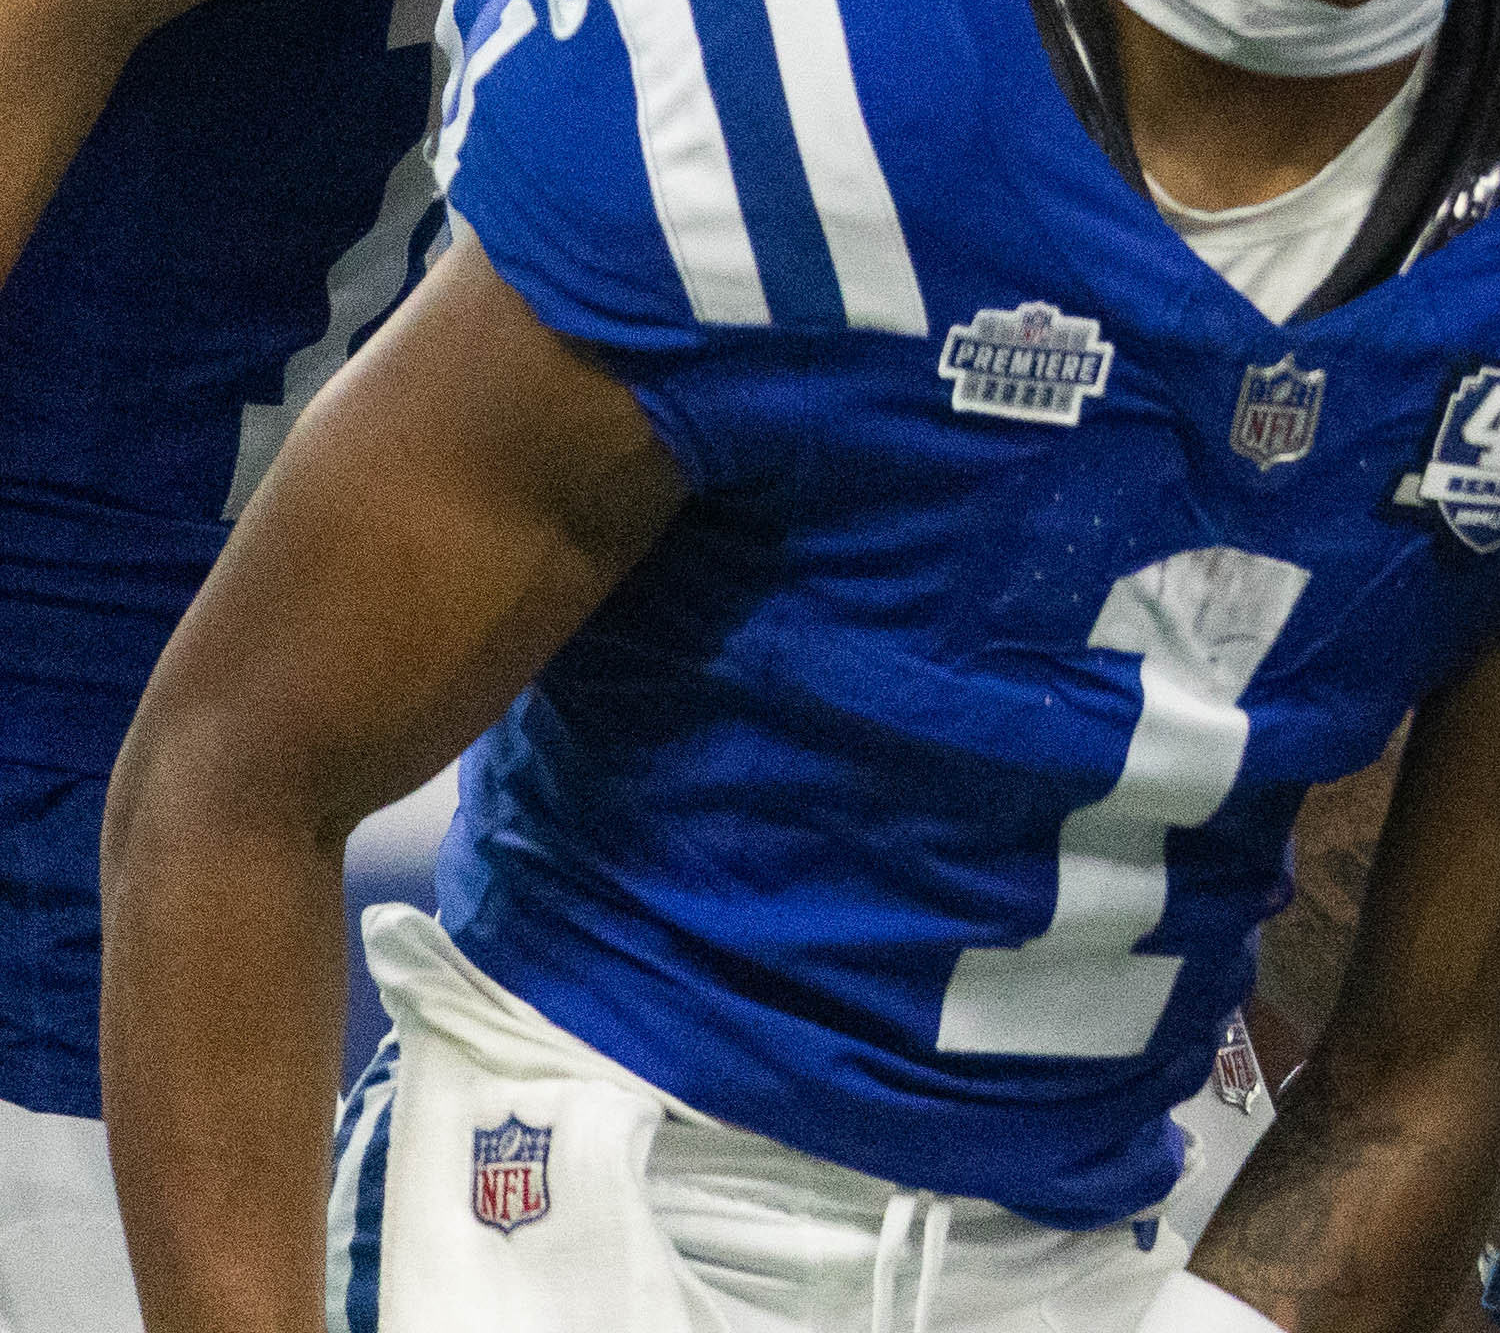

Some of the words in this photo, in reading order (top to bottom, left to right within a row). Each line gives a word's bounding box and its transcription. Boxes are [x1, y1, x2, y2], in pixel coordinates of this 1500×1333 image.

[955, 339, 1098, 385] PREMIERE
[937, 545, 1313, 1058] 1
[480, 1166, 542, 1221] NFL
